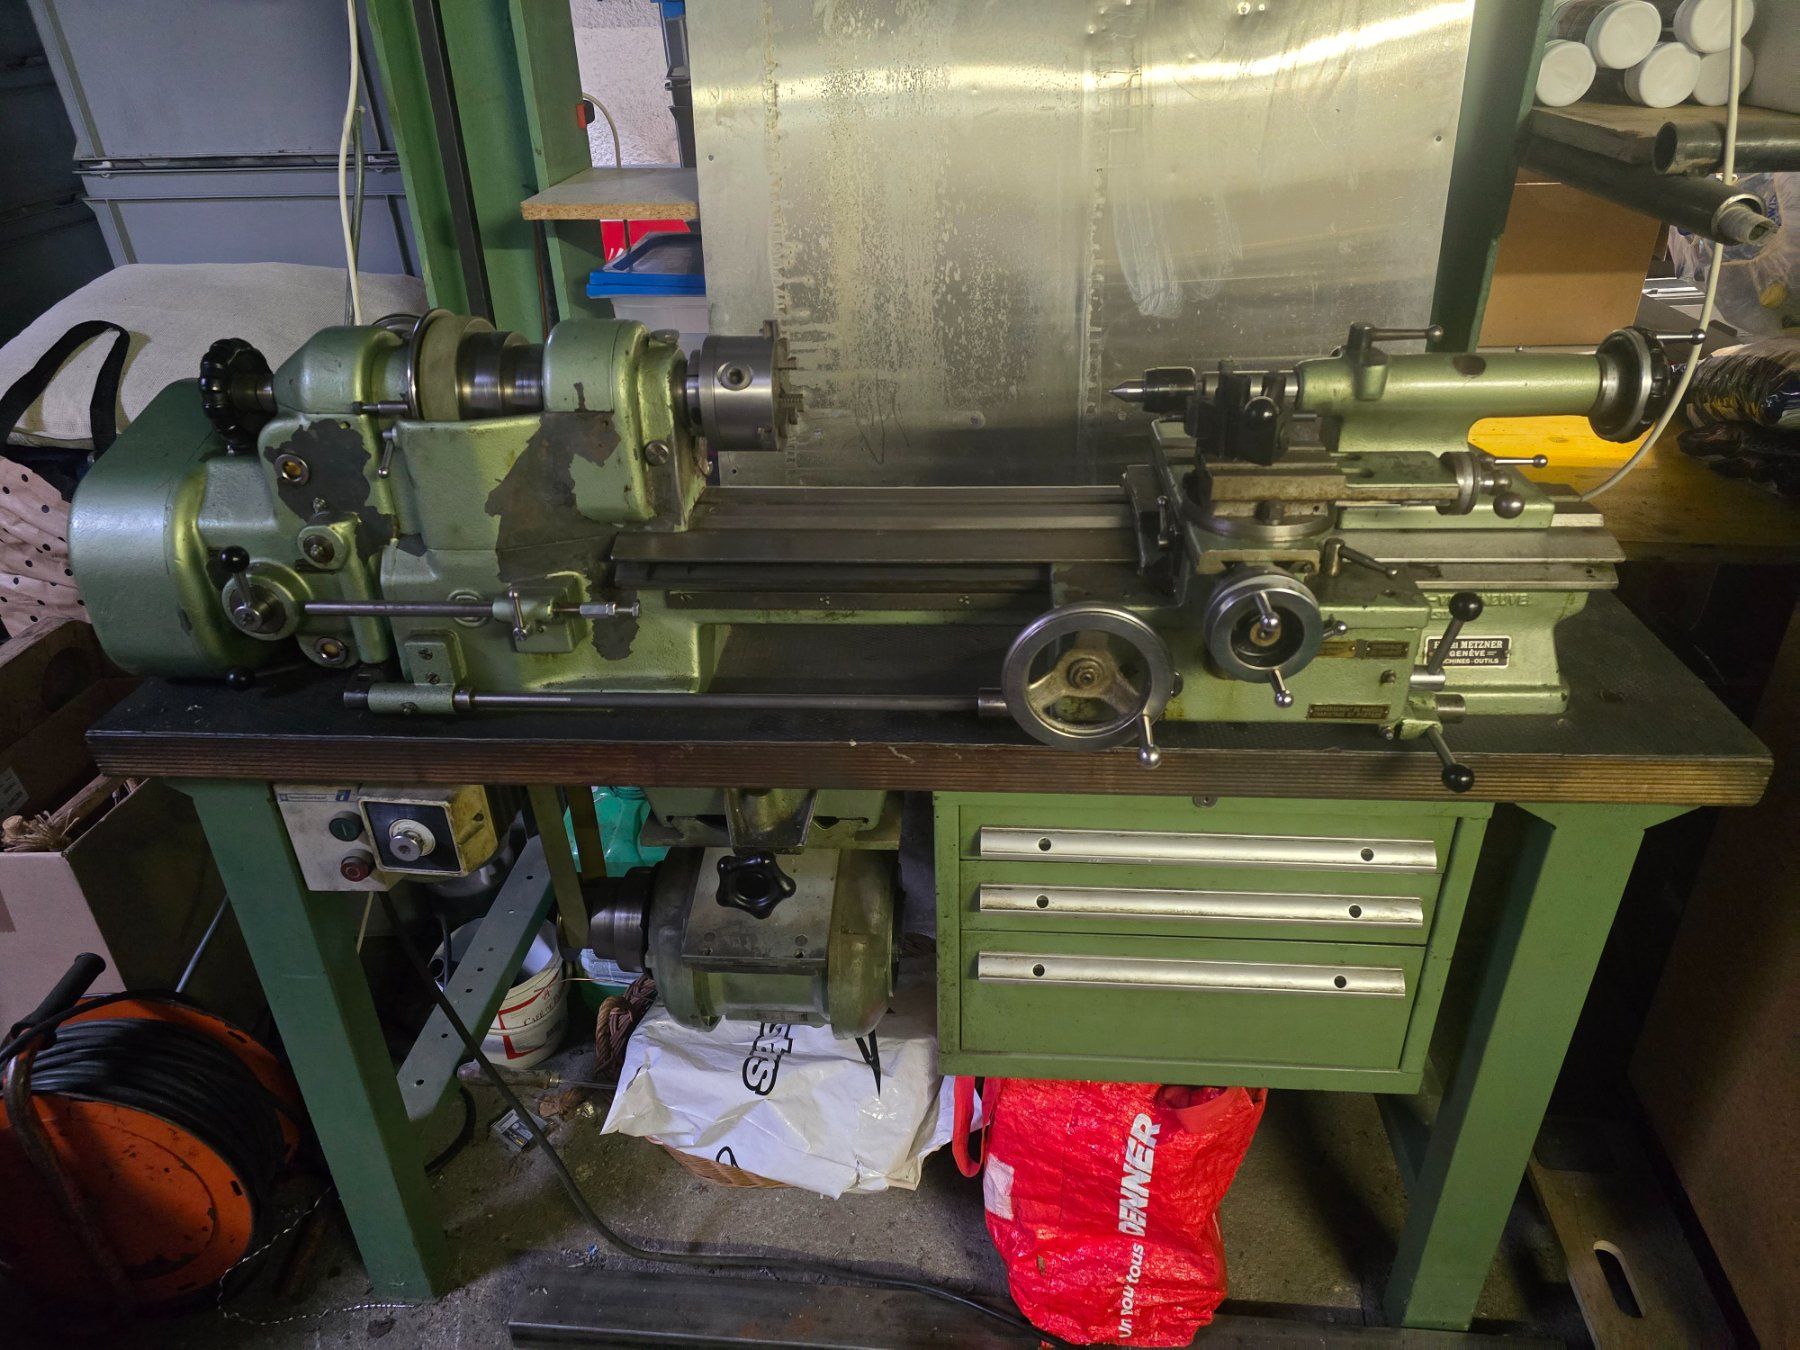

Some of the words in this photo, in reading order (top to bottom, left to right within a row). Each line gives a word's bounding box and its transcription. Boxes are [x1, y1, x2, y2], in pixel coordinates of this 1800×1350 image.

[1460, 640, 1503, 649] METZNER
[1117, 1113, 1161, 1237] DENNER
[1126, 1244, 1145, 1283] tous
[1118, 1318, 1133, 1338] Un
